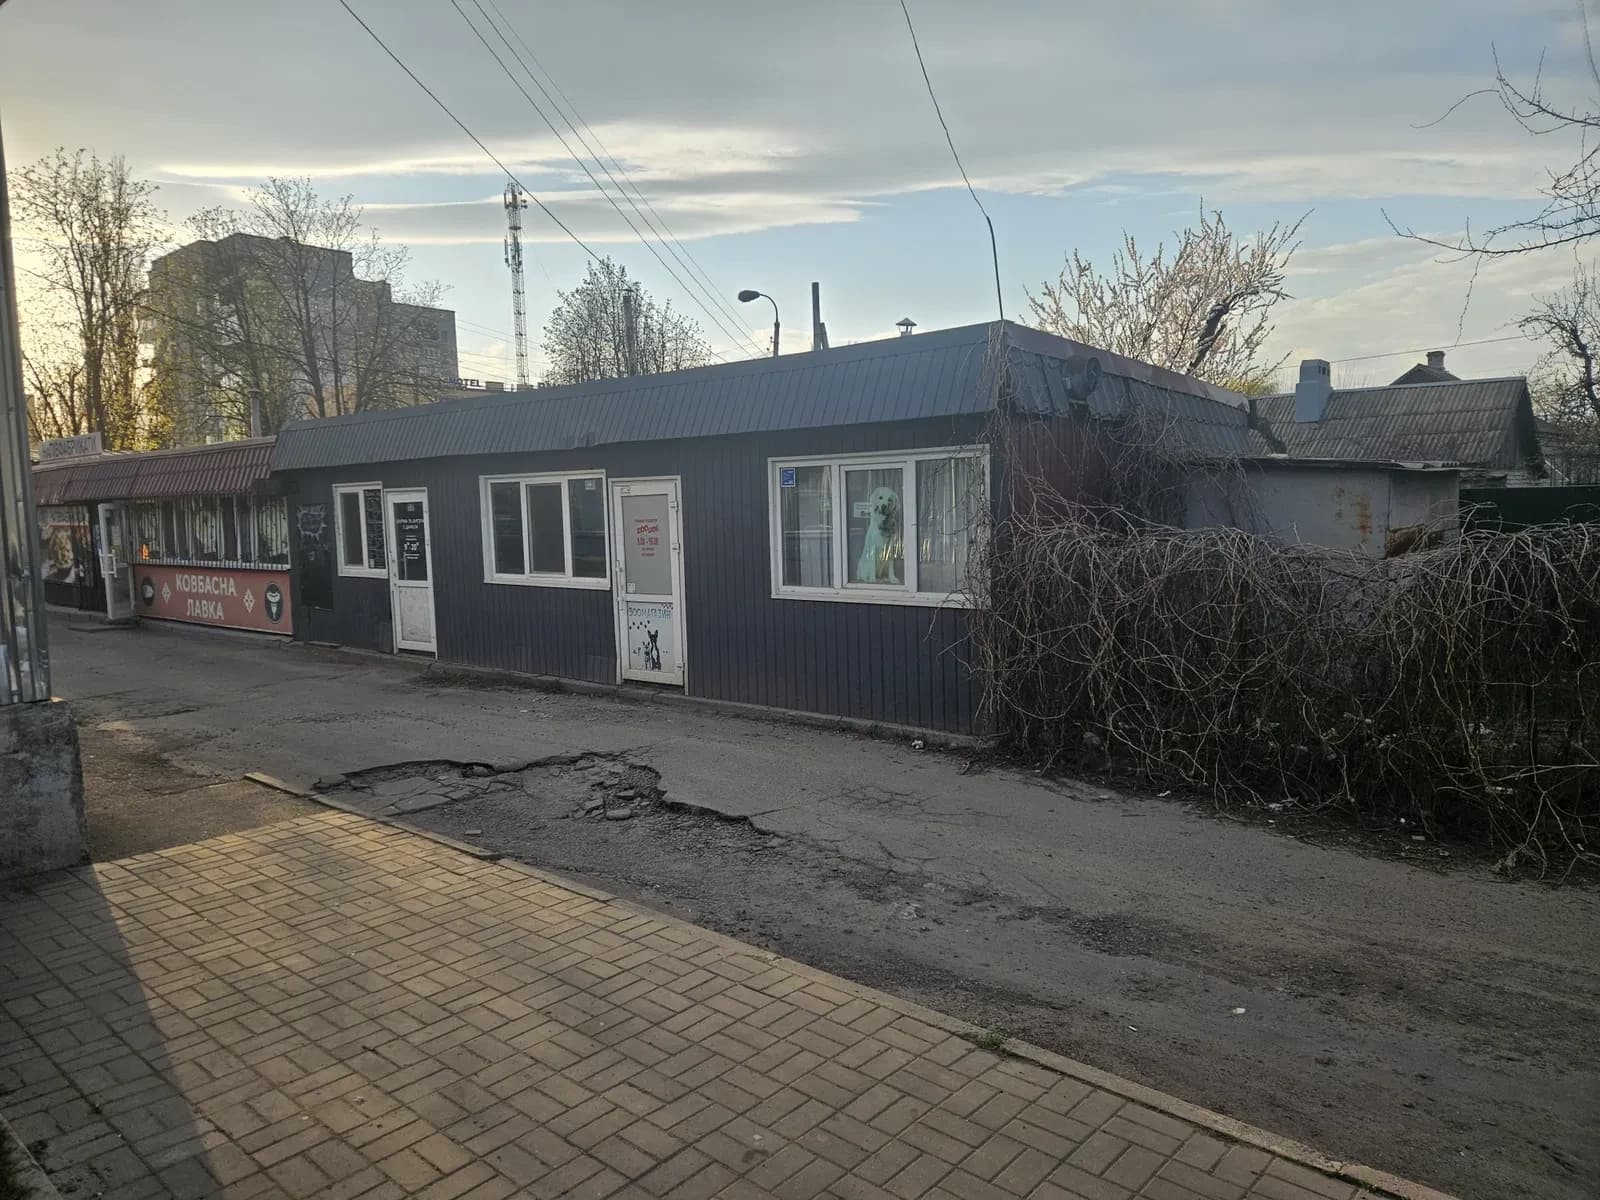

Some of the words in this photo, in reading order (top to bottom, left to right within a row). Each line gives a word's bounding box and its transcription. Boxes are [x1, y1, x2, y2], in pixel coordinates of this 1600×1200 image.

[176, 573, 236, 596] КОВБАСНА
[187, 599, 224, 620] ЛАВКА
[628, 606, 671, 619] ЗООМАГАЗИН
